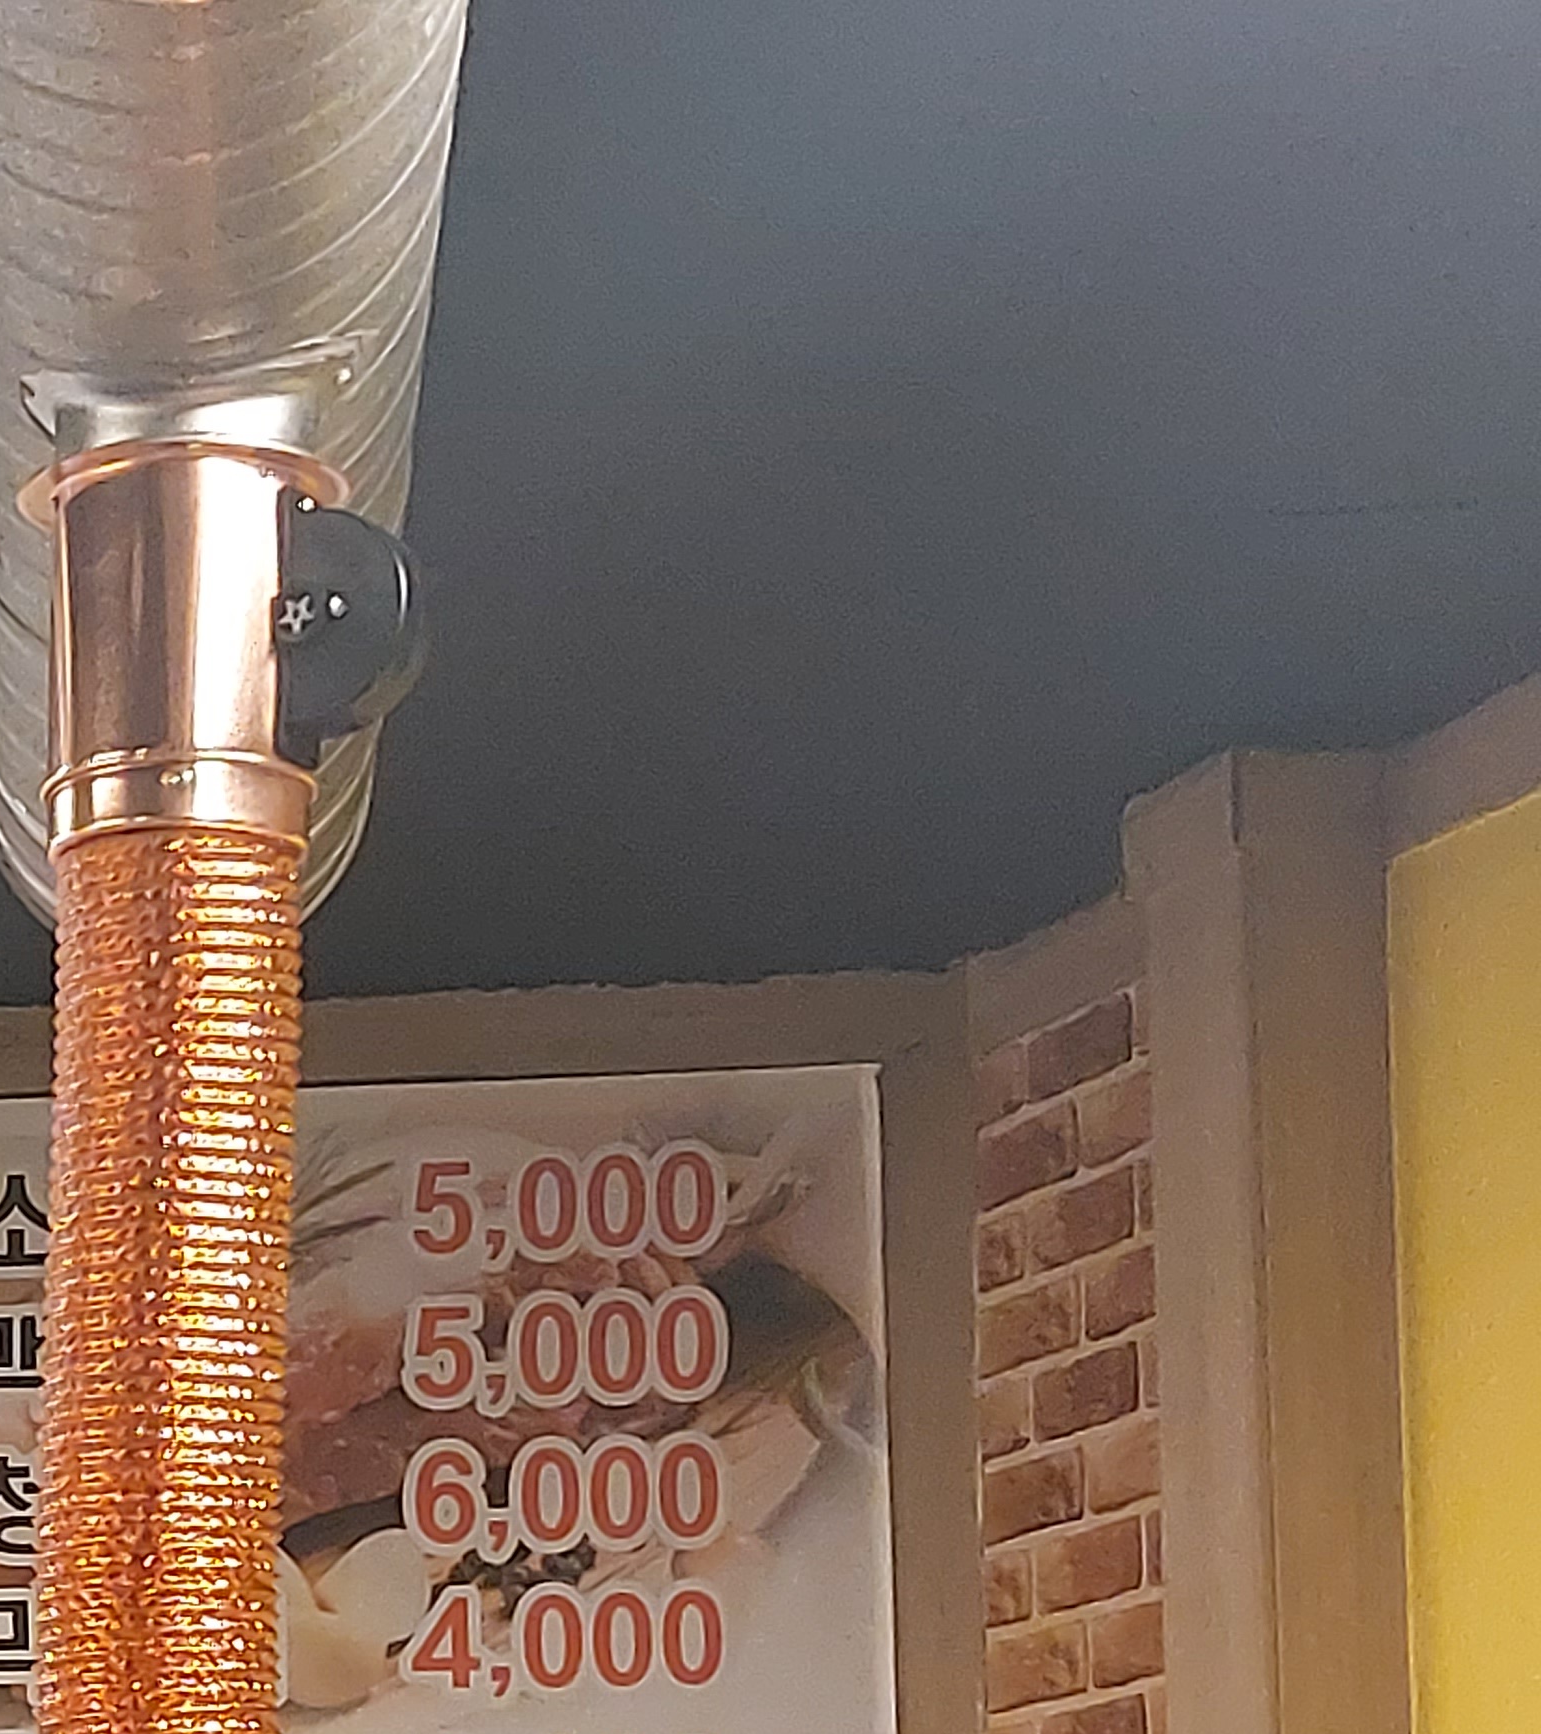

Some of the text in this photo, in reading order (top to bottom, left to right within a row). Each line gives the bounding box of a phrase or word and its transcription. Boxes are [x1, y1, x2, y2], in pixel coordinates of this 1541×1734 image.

[411, 1159, 719, 1256] 5,000
[411, 1297, 719, 1402] 5,000
[412, 1443, 720, 1554] 6,000
[410, 1588, 723, 1698] 4,000
